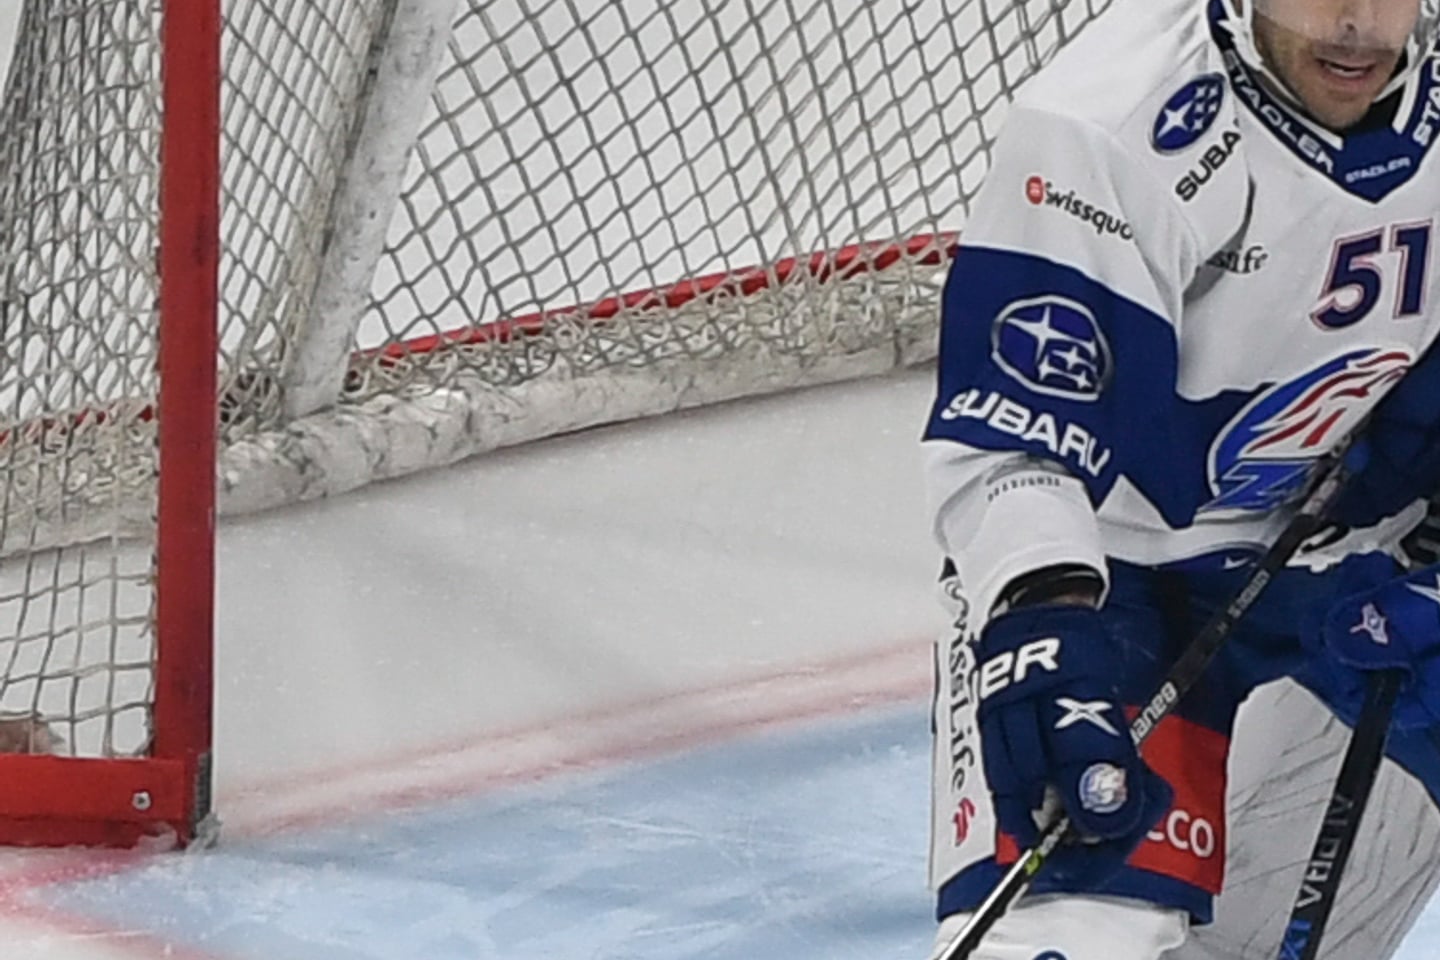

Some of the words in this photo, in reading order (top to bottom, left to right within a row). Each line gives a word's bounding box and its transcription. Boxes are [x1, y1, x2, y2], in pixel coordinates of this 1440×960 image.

[1223, 48, 1334, 174] STADLER
[1175, 119, 1242, 203] SUBA
[1345, 157, 1411, 183] STADLER
[1309, 217, 1434, 333] 51
[940, 388, 1111, 478] SUBARU
[976, 637, 1062, 700] ER
